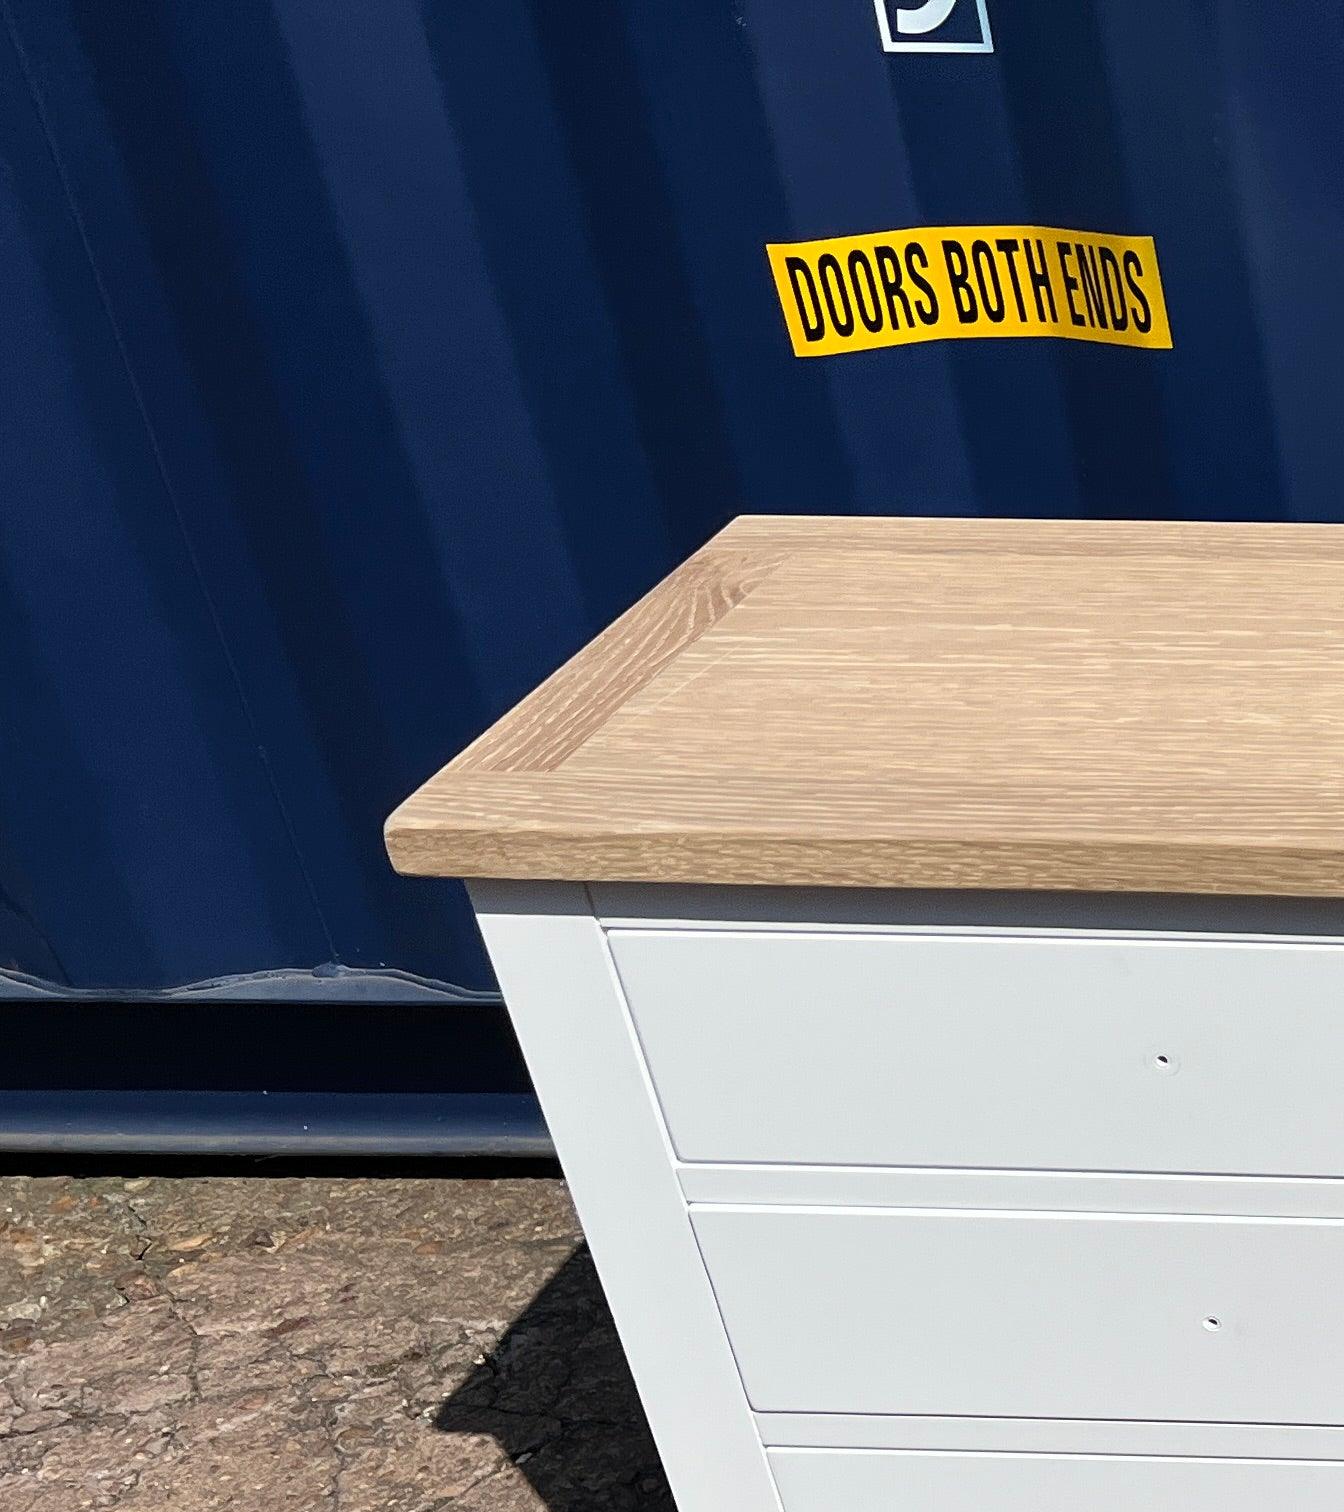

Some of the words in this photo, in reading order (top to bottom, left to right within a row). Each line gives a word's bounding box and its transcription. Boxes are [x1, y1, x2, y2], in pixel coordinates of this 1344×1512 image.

[785, 242, 939, 342] DOORS
[941, 239, 1059, 324] BOTH
[1056, 241, 1152, 334] ENDS
